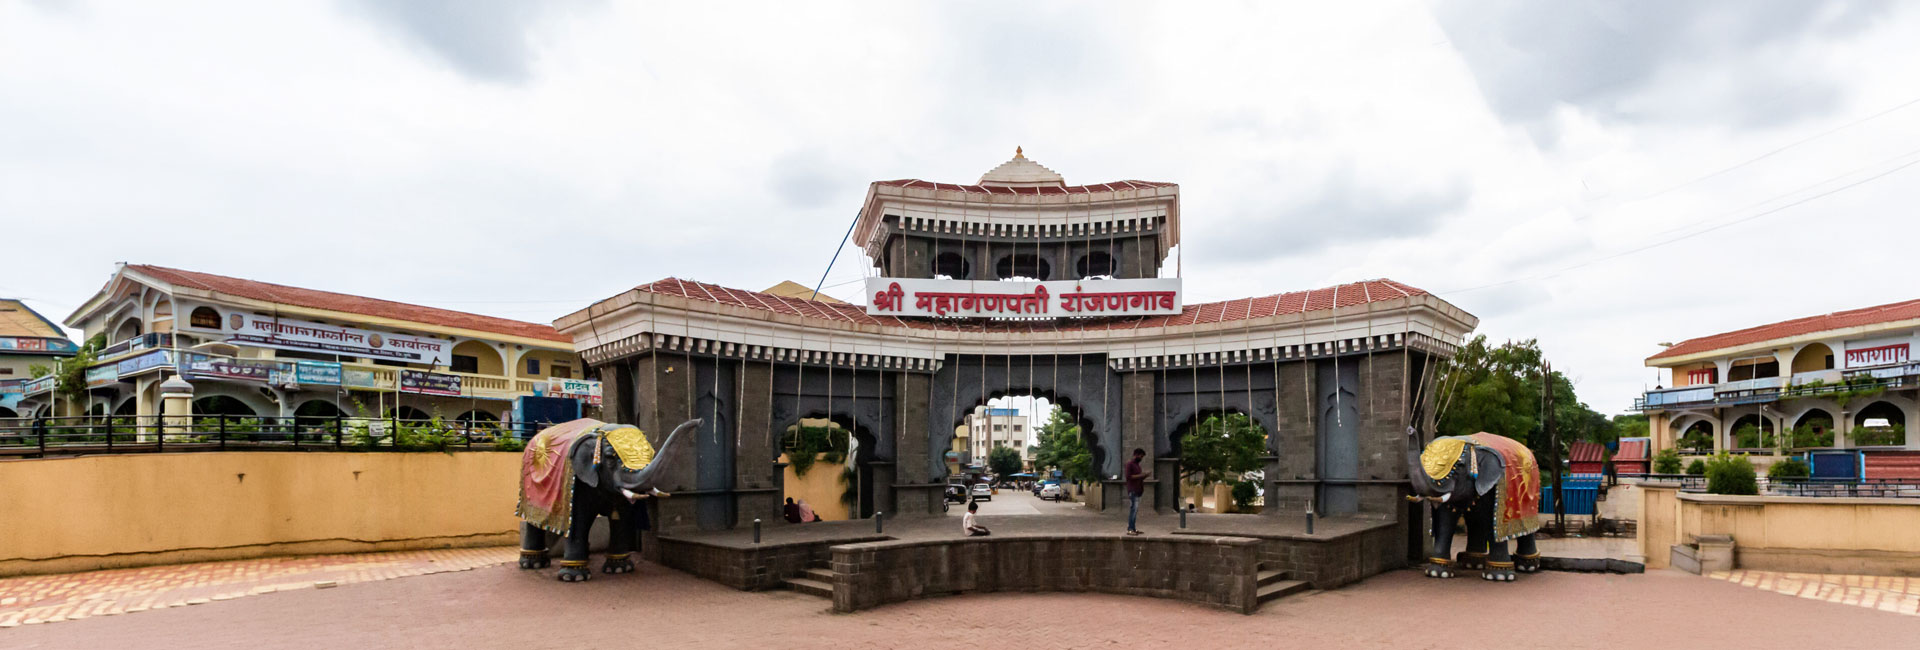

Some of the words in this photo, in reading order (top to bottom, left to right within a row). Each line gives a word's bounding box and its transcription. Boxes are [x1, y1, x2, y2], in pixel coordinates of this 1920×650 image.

[873, 282, 904, 312] श्री
[915, 285, 1049, 316] महागणपती
[1059, 285, 1177, 312] रांजणगाव
[388, 337, 441, 352] कार्यालय
